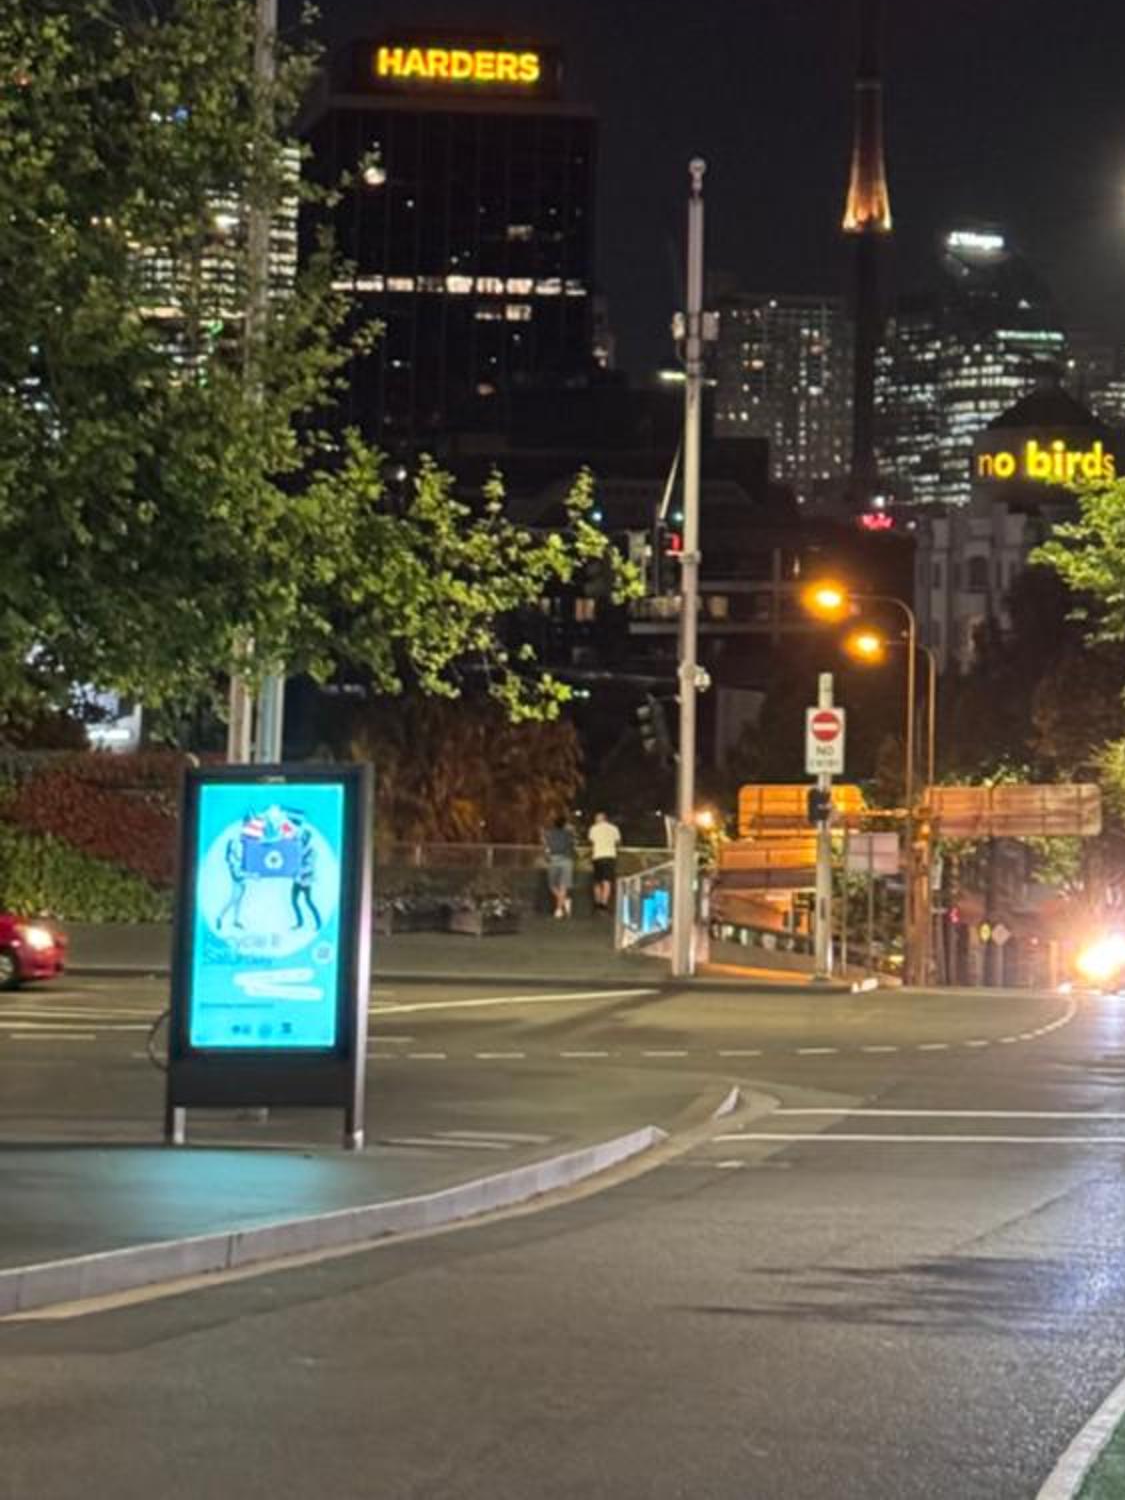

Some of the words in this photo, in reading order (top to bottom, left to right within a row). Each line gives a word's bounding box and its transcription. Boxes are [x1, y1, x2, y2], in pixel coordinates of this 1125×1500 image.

[378, 47, 540, 82] HARDERS
[978, 451, 1016, 478] no
[1026, 439, 1116, 482] birds
